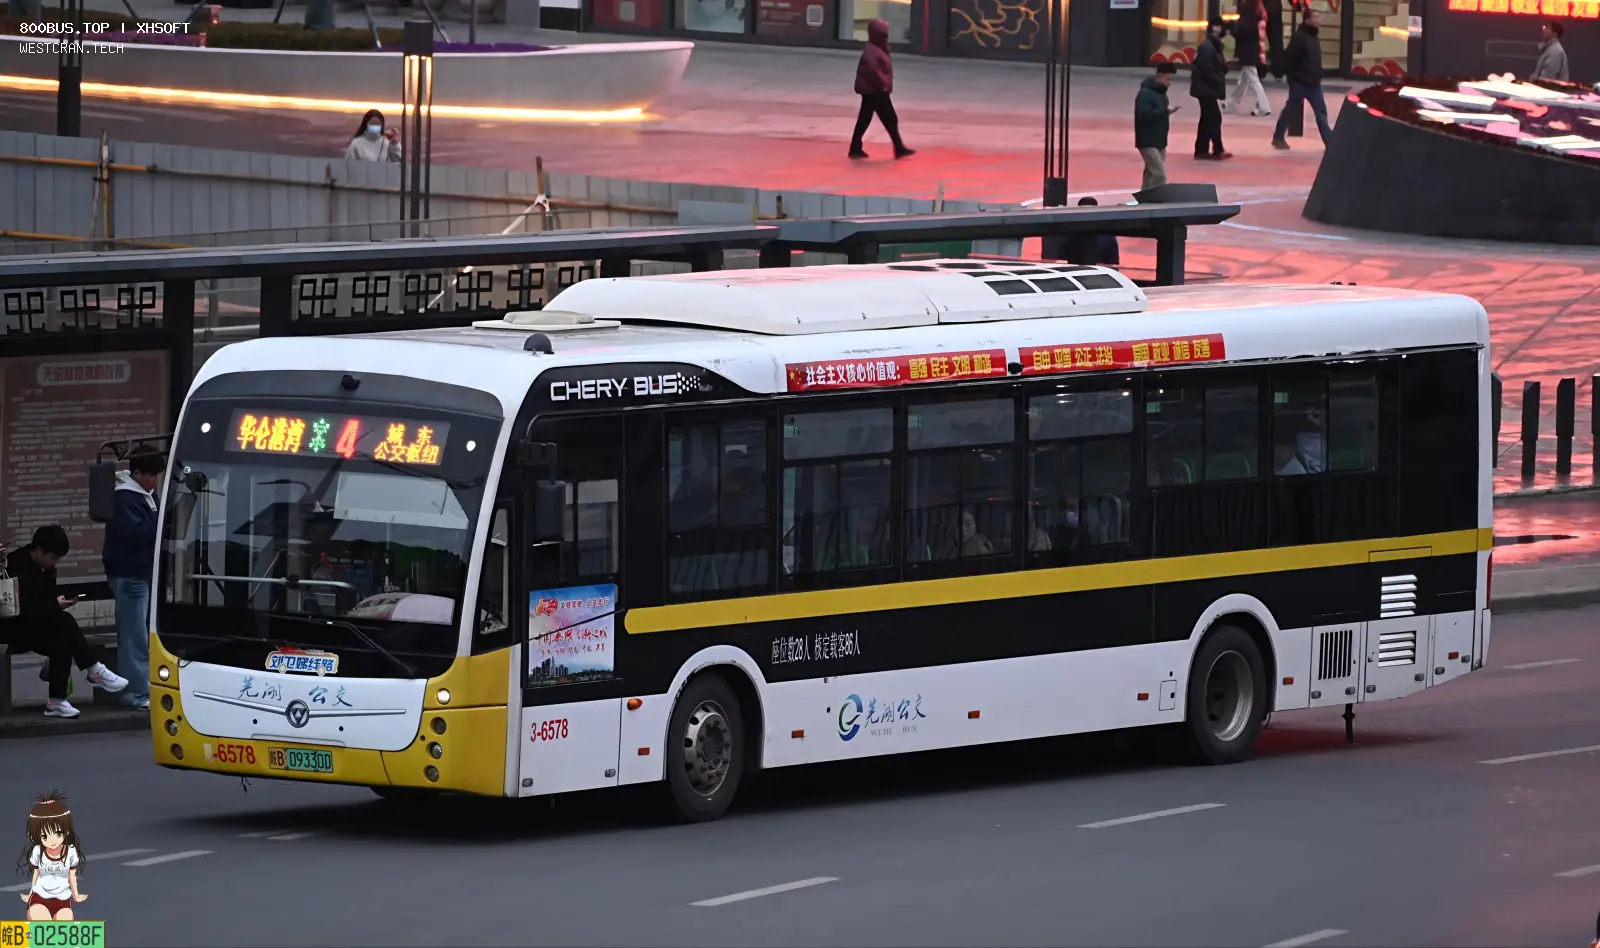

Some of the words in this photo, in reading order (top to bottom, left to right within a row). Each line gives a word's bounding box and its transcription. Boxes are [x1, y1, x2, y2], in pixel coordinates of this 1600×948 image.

[909, 357, 928, 379] 富强
[930, 356, 950, 377] 民主
[952, 354, 971, 375] 文明
[973, 353, 992, 374] 和谐
[1033, 350, 1051, 370] 自由
[1054, 348, 1072, 368] 平等
[1075, 347, 1092, 367] 公正
[1095, 346, 1113, 366] 法治
[1172, 340, 1189, 361] 诚信
[1193, 338, 1210, 358] 友善
[550, 378, 627, 401] CHERY
[634, 374, 678, 396] BUS
[336, 418, 360, 458] 4
[374, 441, 440, 464] 公交枢纽
[771, 635, 811, 665] 座位数28人
[814, 629, 861, 661] 核定载客86人
[270, 655, 334, 672] 刘卫娣线路
[309, 684, 353, 707] 公交
[530, 718, 569, 743] 3-6578
[204, 743, 256, 765] -6578
